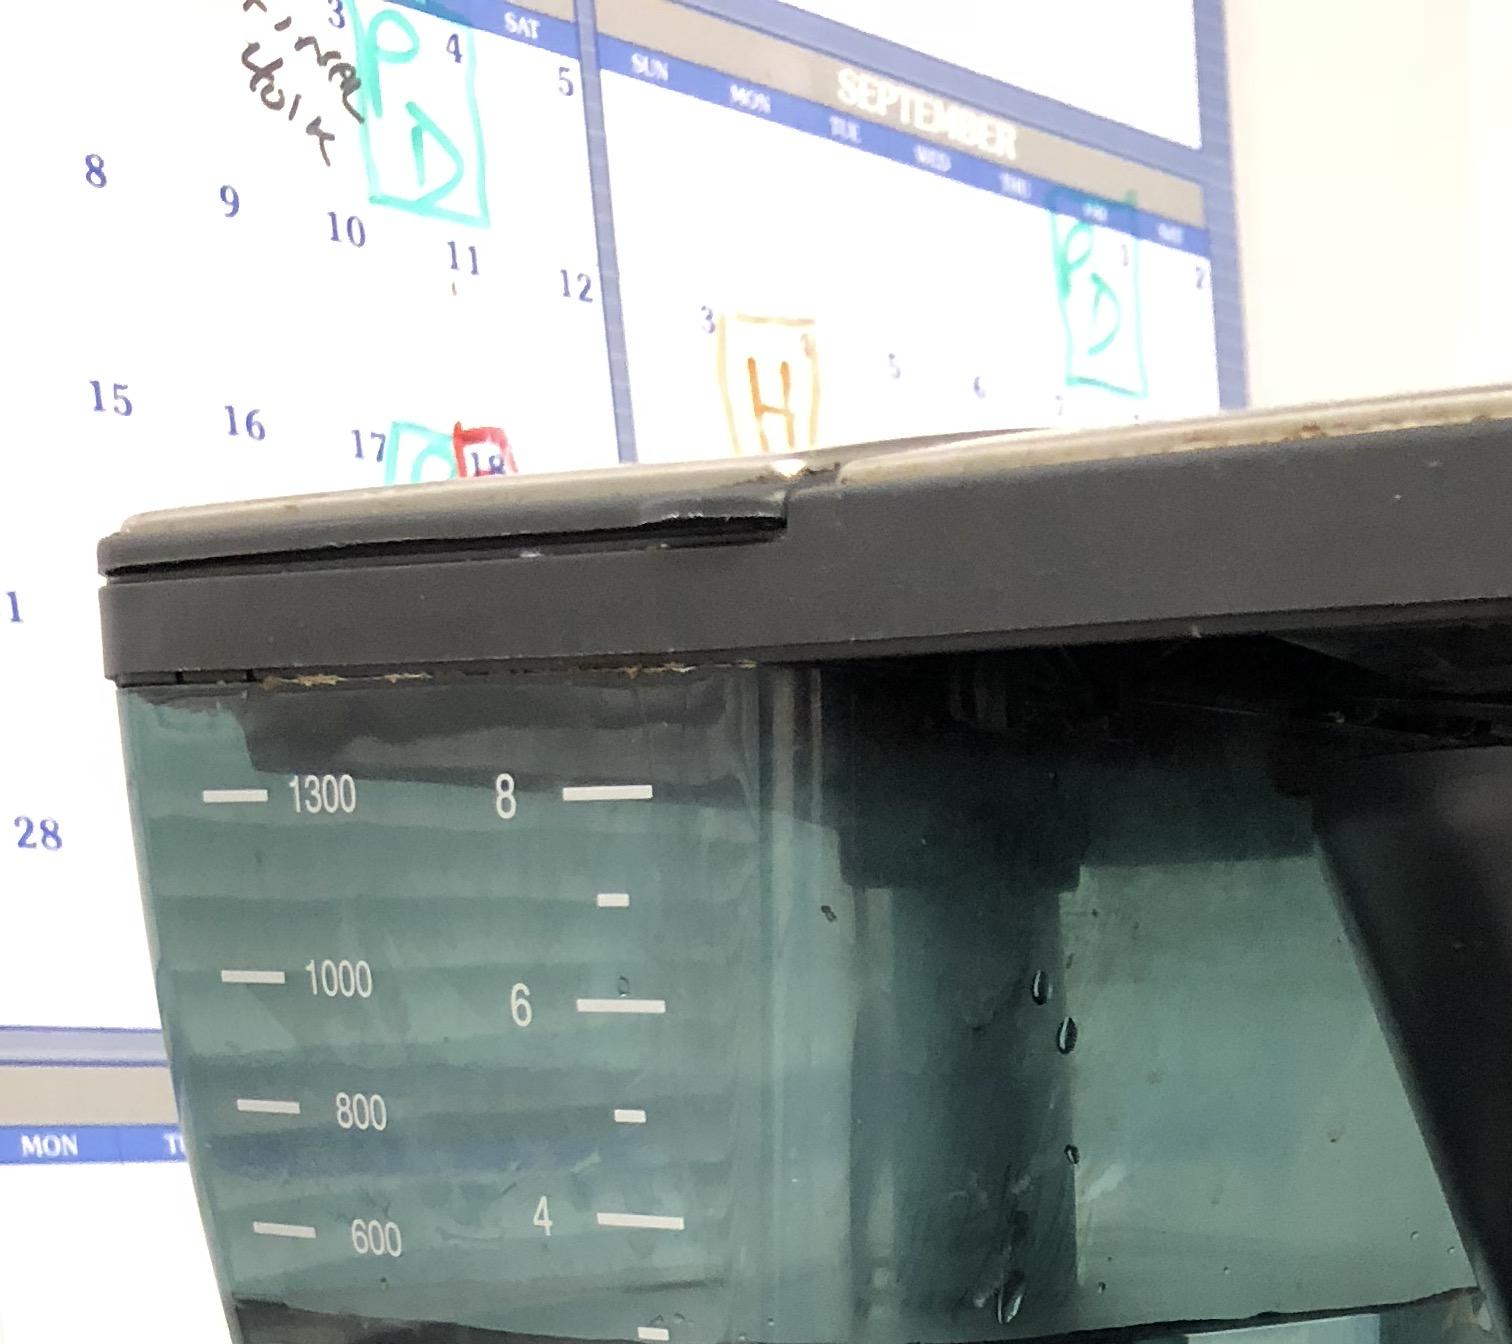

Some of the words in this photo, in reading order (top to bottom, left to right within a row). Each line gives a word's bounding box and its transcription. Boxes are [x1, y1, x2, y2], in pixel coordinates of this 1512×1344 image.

[503, 11, 540, 39] SAT
[446, 33, 463, 63] 4
[558, 67, 575, 96] 5
[630, 52, 670, 83] SUN
[729, 83, 773, 116] MON
[836, 66, 1017, 161] SEPTEMBER
[85, 154, 107, 188] 8
[220, 185, 240, 218] 9
[328, 211, 367, 248] 10
[447, 241, 480, 276] 11
[559, 269, 594, 303] 12
[700, 304, 716, 334] 3
[89, 380, 133, 418] 15
[224, 405, 267, 441] 16
[351, 429, 387, 463] 17
[7, 591, 24, 624] 1
[288, 773, 357, 814] 1300
[494, 772, 518, 820] 8
[14, 816, 63, 851] 28
[304, 958, 373, 999] 1000
[509, 981, 533, 1027] 6
[335, 1091, 388, 1131] 800
[21, 1133, 79, 1158] MON
[532, 1195, 553, 1238] 4
[350, 1218, 403, 1258] 600
